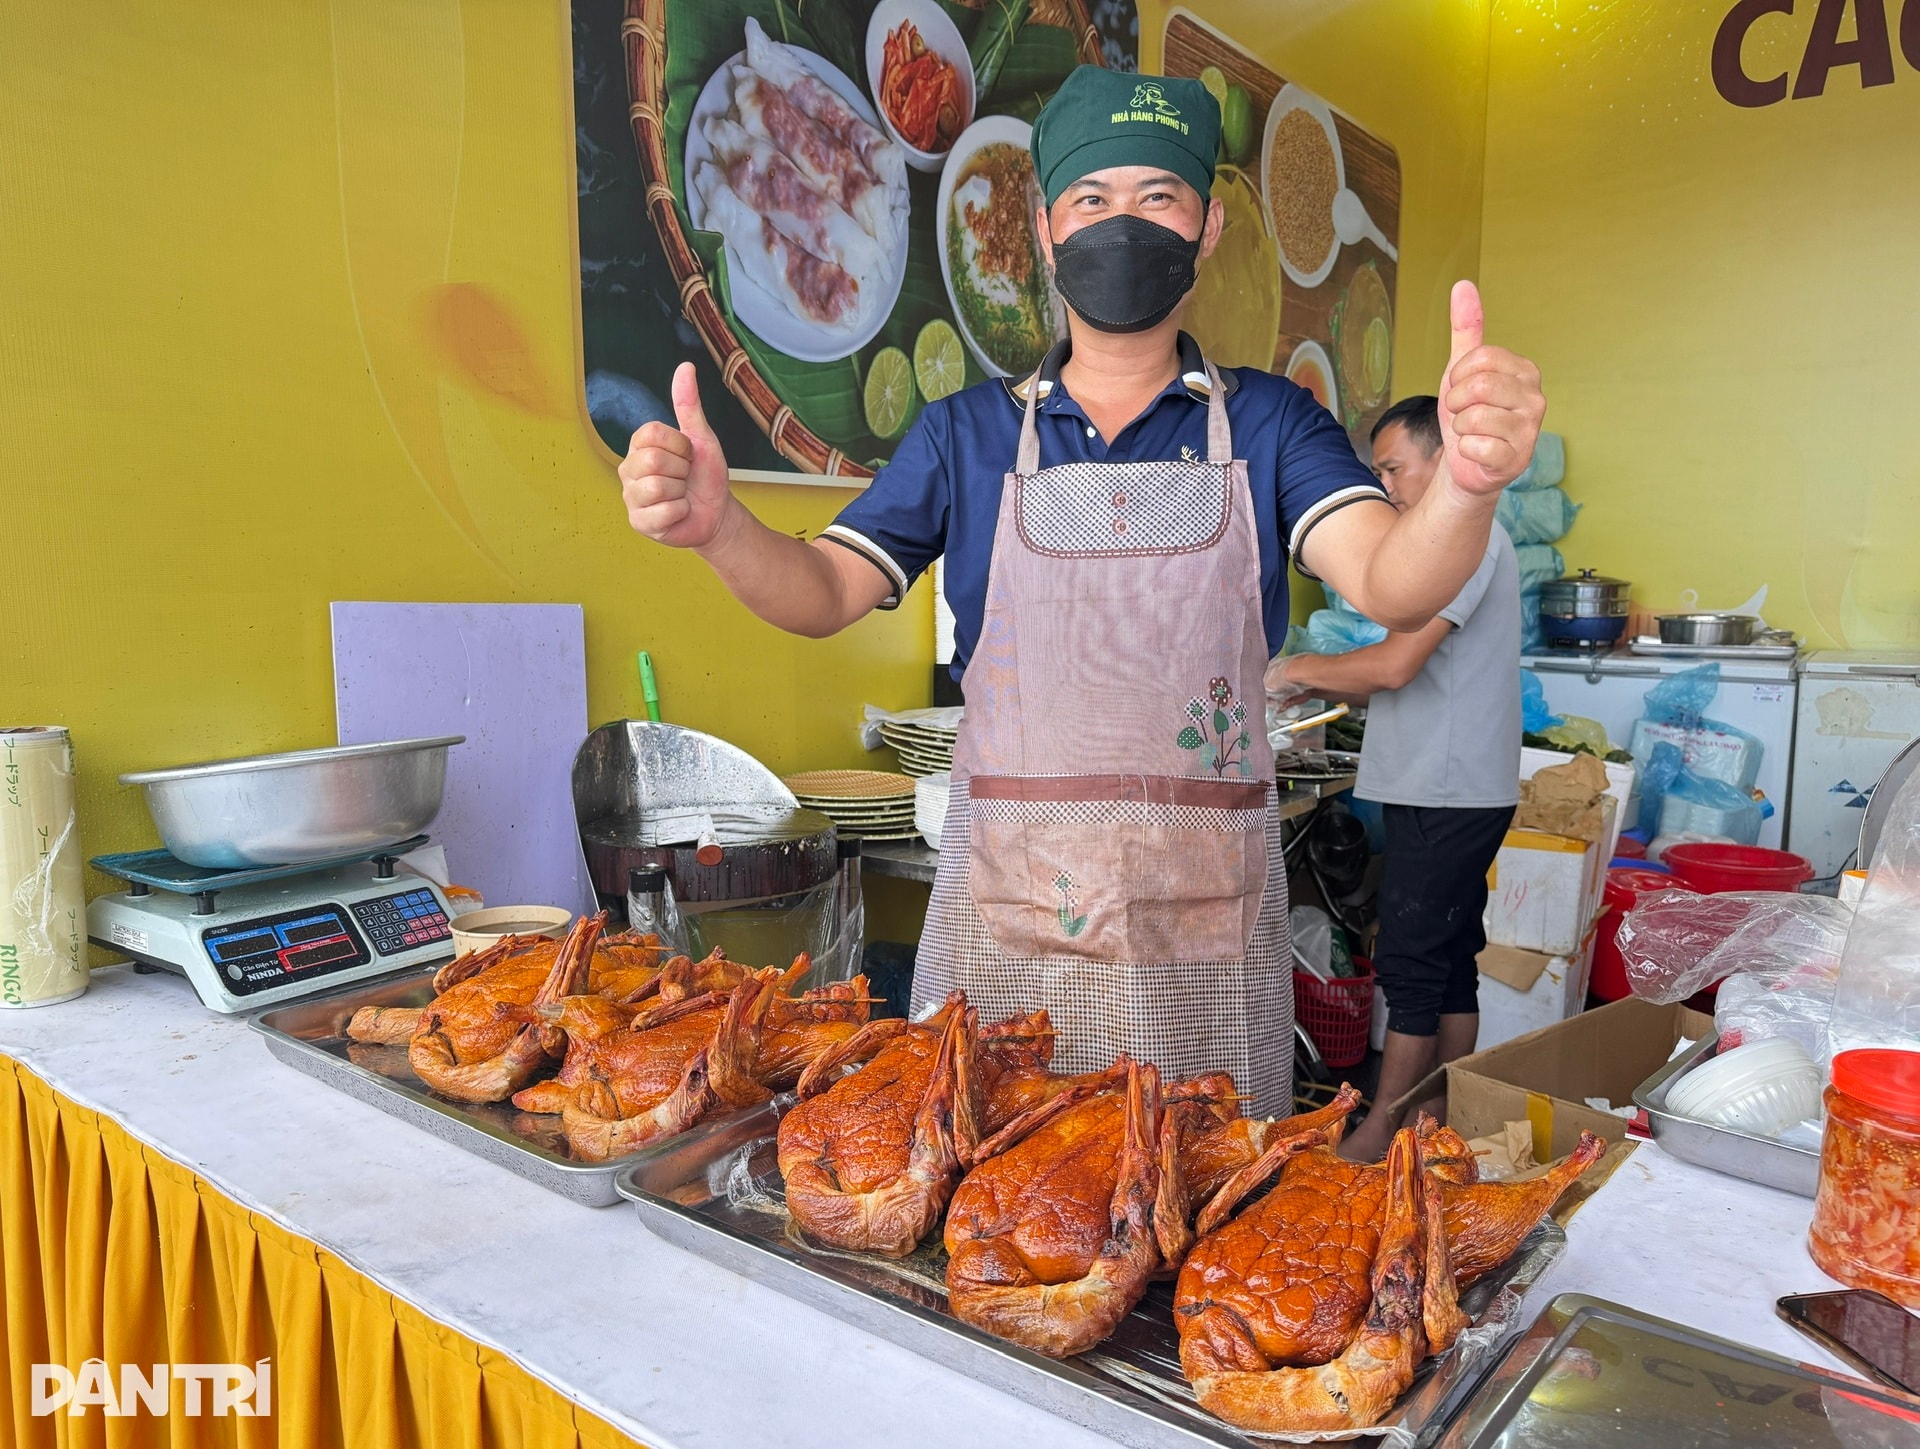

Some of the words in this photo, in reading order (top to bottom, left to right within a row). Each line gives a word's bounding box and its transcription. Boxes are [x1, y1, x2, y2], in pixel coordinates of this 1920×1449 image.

[1711, 0, 1920, 108] CA
[1111, 110, 1129, 124] NHÀ
[1130, 110, 1154, 122] HÀNG
[1155, 113, 1180, 131] PHONG
[1180, 122, 1190, 136] TÚ
[3, 737, 22, 807] フードラップ
[0, 944, 22, 1005] RINGO
